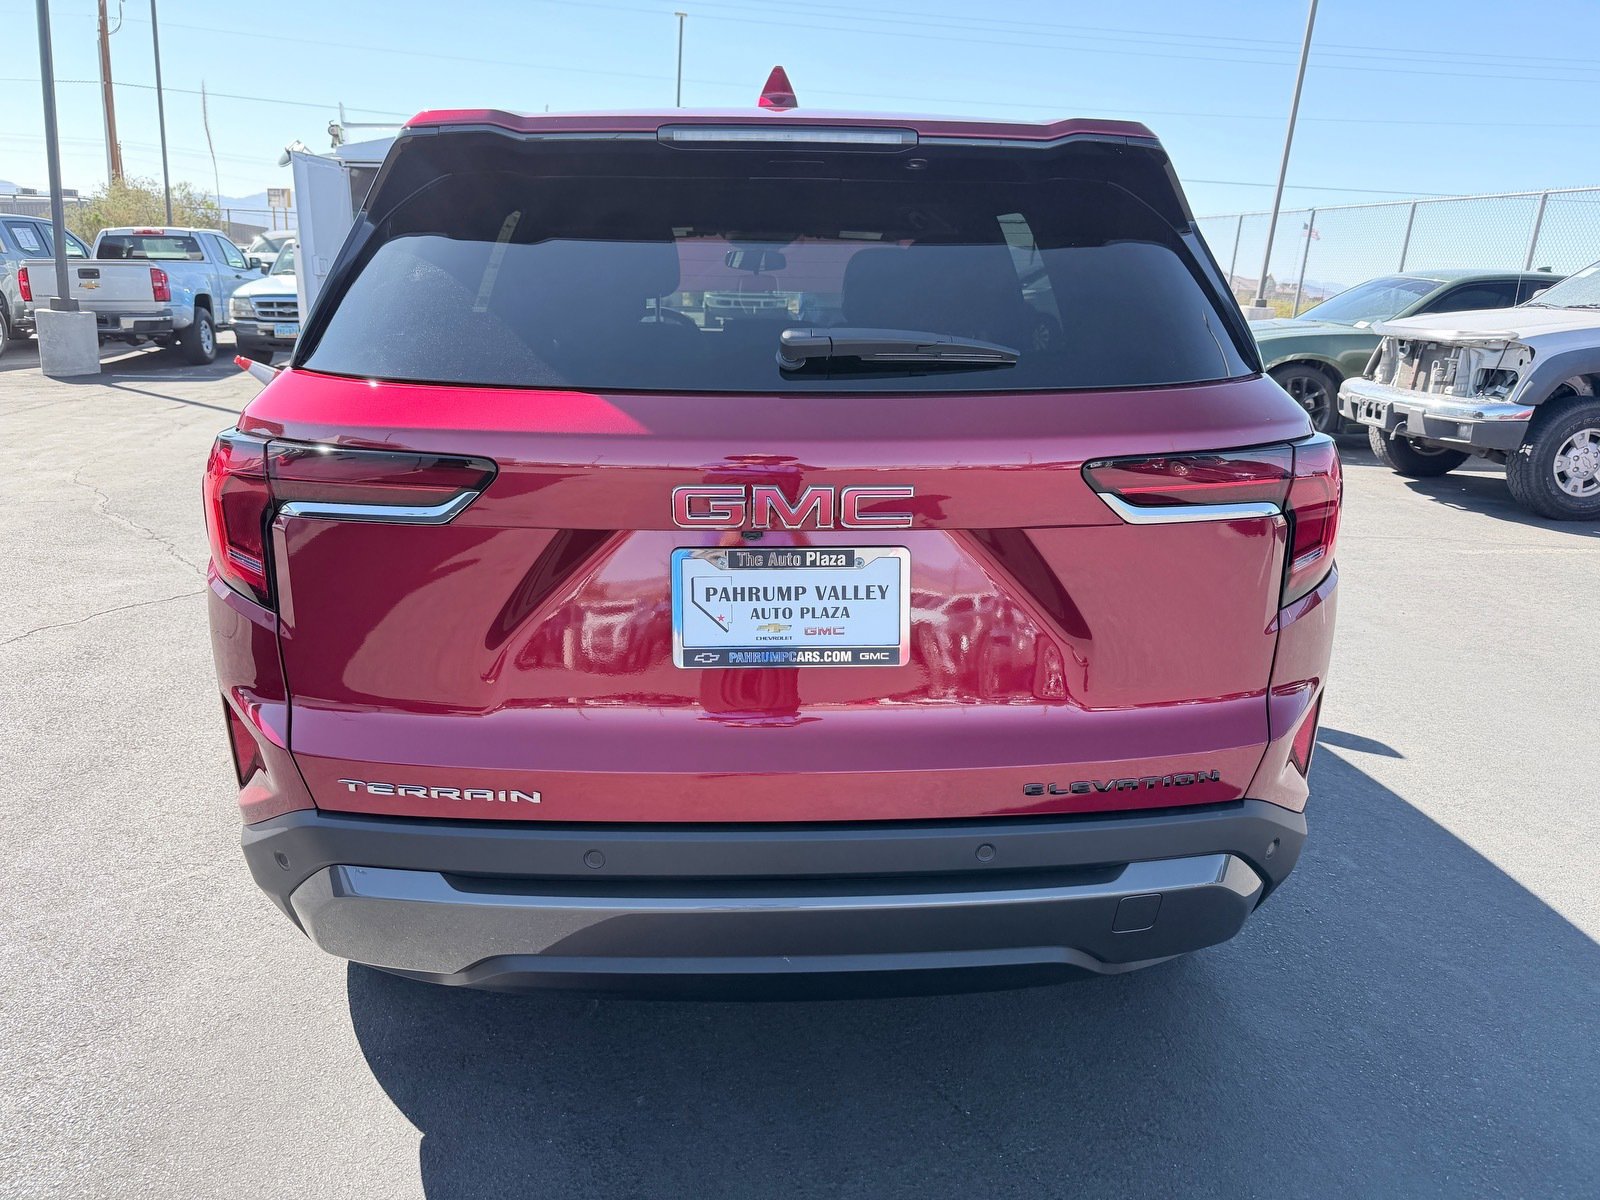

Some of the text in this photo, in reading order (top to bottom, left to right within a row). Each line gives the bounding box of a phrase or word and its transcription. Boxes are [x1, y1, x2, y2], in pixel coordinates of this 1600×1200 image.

[671, 485, 915, 529] GMC
[736, 551, 846, 567] The Auto Plaza
[705, 584, 890, 603] PAHRUMP VALLEY
[750, 606, 850, 620] AUTO PLAZA
[804, 626, 845, 636] GMC
[729, 651, 852, 663] PAHRUMPCARS.COM
[859, 652, 890, 661] GMC
[1023, 769, 1221, 796] ELEVATION
[337, 778, 542, 804] TERRAIN
